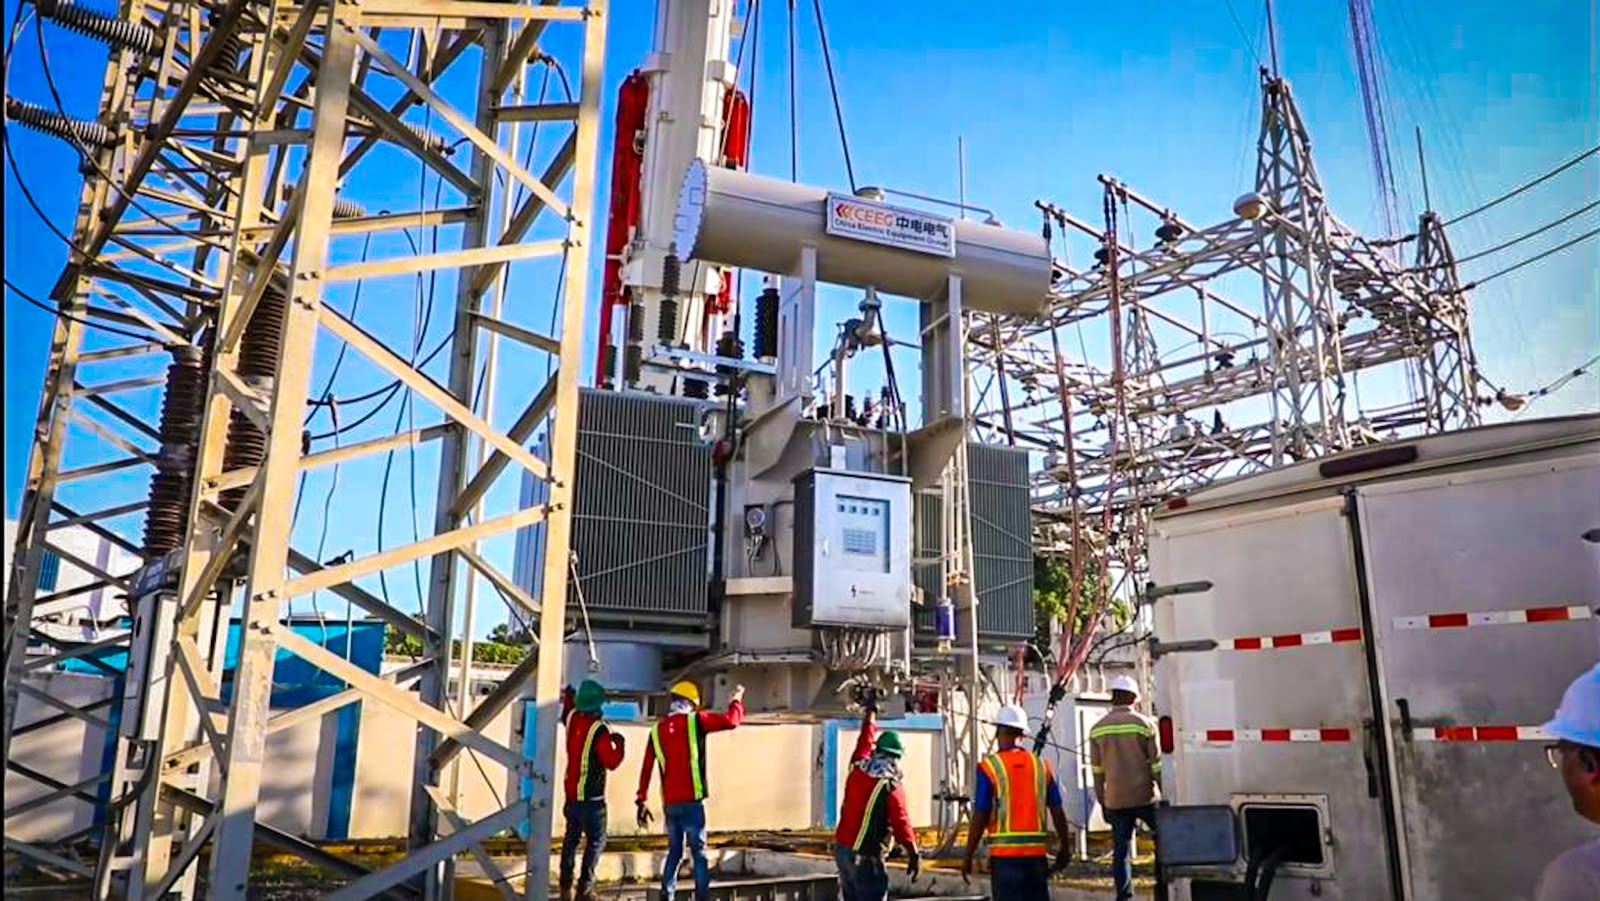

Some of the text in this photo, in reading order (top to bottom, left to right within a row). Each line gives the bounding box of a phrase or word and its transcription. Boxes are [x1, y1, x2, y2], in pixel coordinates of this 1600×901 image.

[834, 218, 856, 229] China
[886, 227, 925, 242] Equipment
[896, 216, 949, 239] 中电电气
